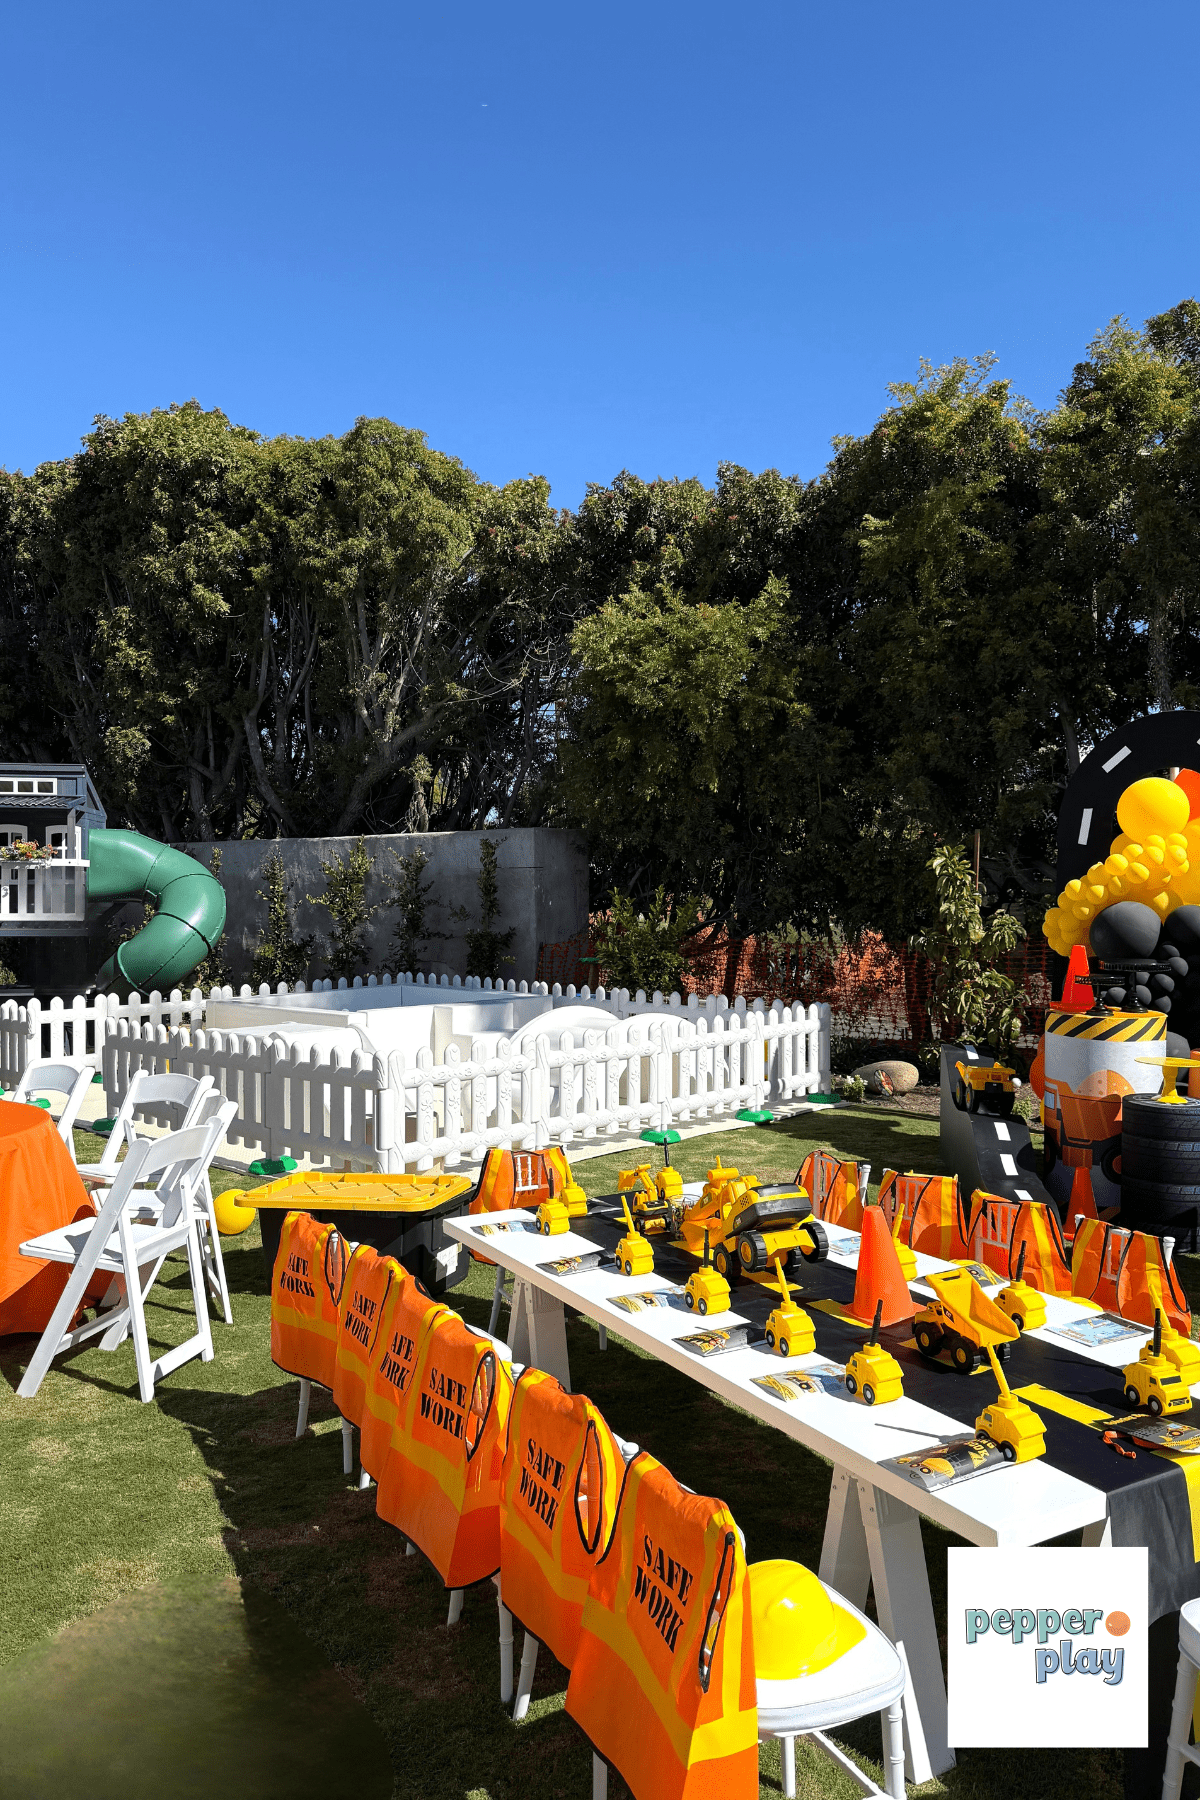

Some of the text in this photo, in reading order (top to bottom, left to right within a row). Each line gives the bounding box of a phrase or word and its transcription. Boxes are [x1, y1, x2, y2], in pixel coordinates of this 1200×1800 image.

[345, 1310, 373, 1349] WORK
[352, 1290, 377, 1323] SAFE
[391, 1331, 415, 1363] AFE
[429, 1367, 467, 1410] SAFE
[527, 1438, 566, 1492] SAFE
[519, 1465, 560, 1531] WORK
[643, 1534, 694, 1607] SAFE
[634, 1564, 685, 1654] WORK
